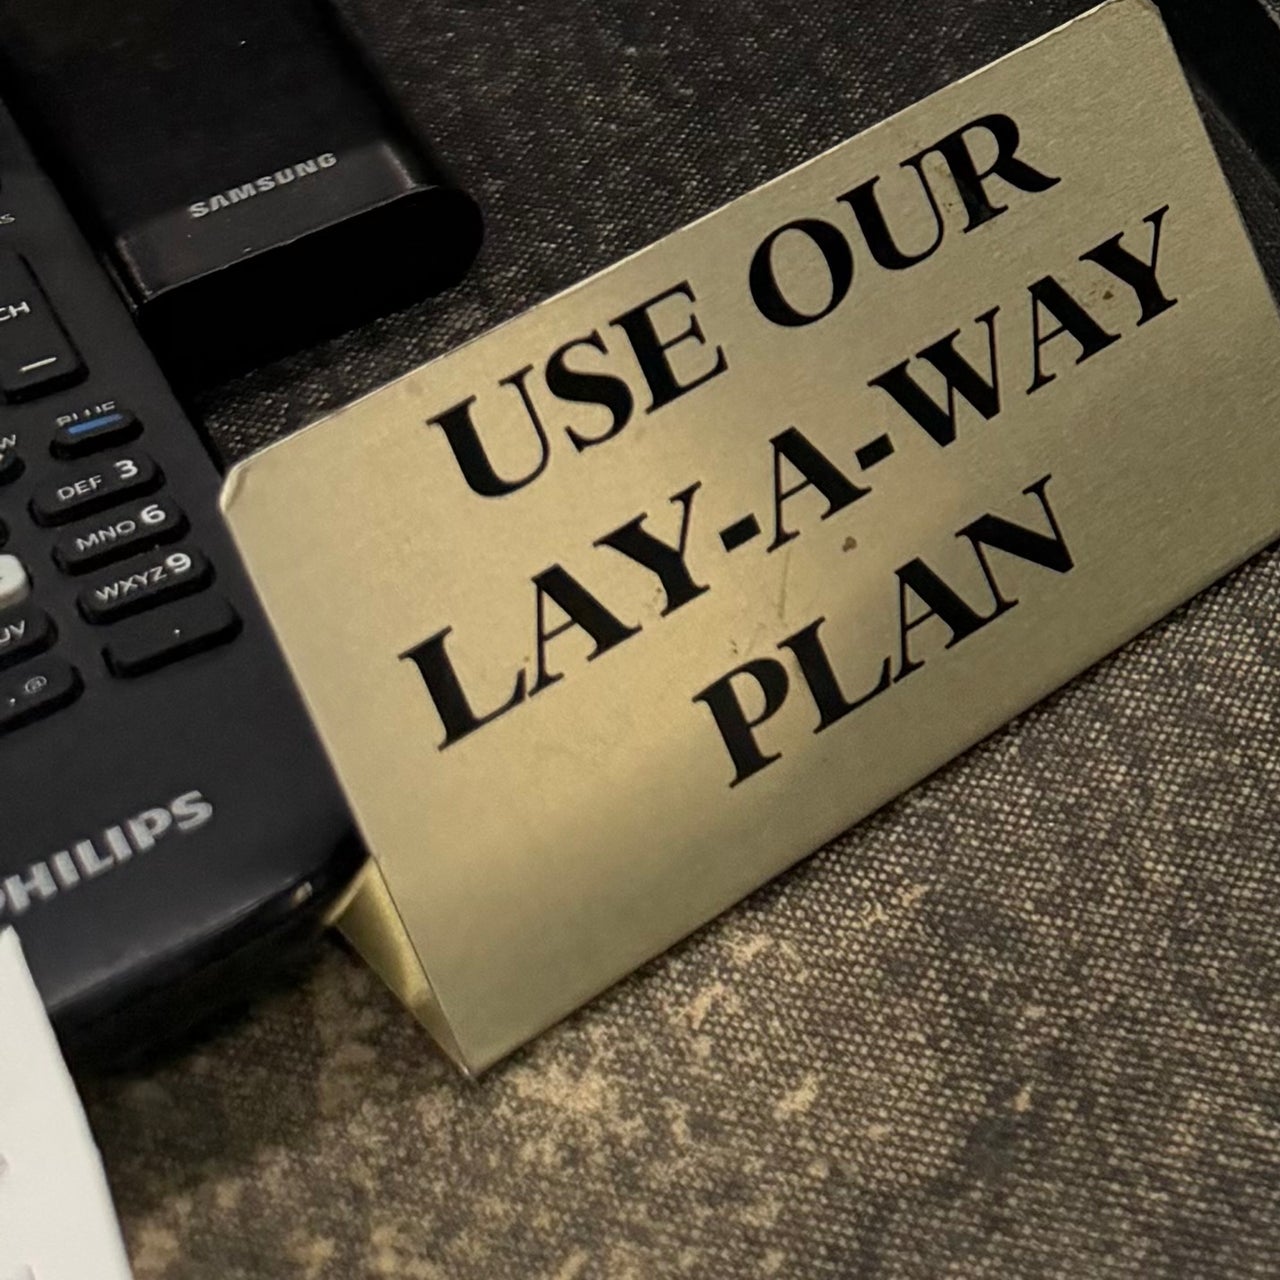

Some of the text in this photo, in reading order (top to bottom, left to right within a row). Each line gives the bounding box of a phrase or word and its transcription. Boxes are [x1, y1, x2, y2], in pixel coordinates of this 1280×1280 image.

[188, 152, 337, 218] SAMSUNG
[425, 112, 1061, 500] USE OUR
[57, 459, 139, 501] DEF 3
[398, 206, 1178, 752] LAY-A-WAY
[75, 504, 166, 552] MNO 6
[95, 552, 192, 602] WXYZ 9
[690, 474, 1076, 788] PLAN
